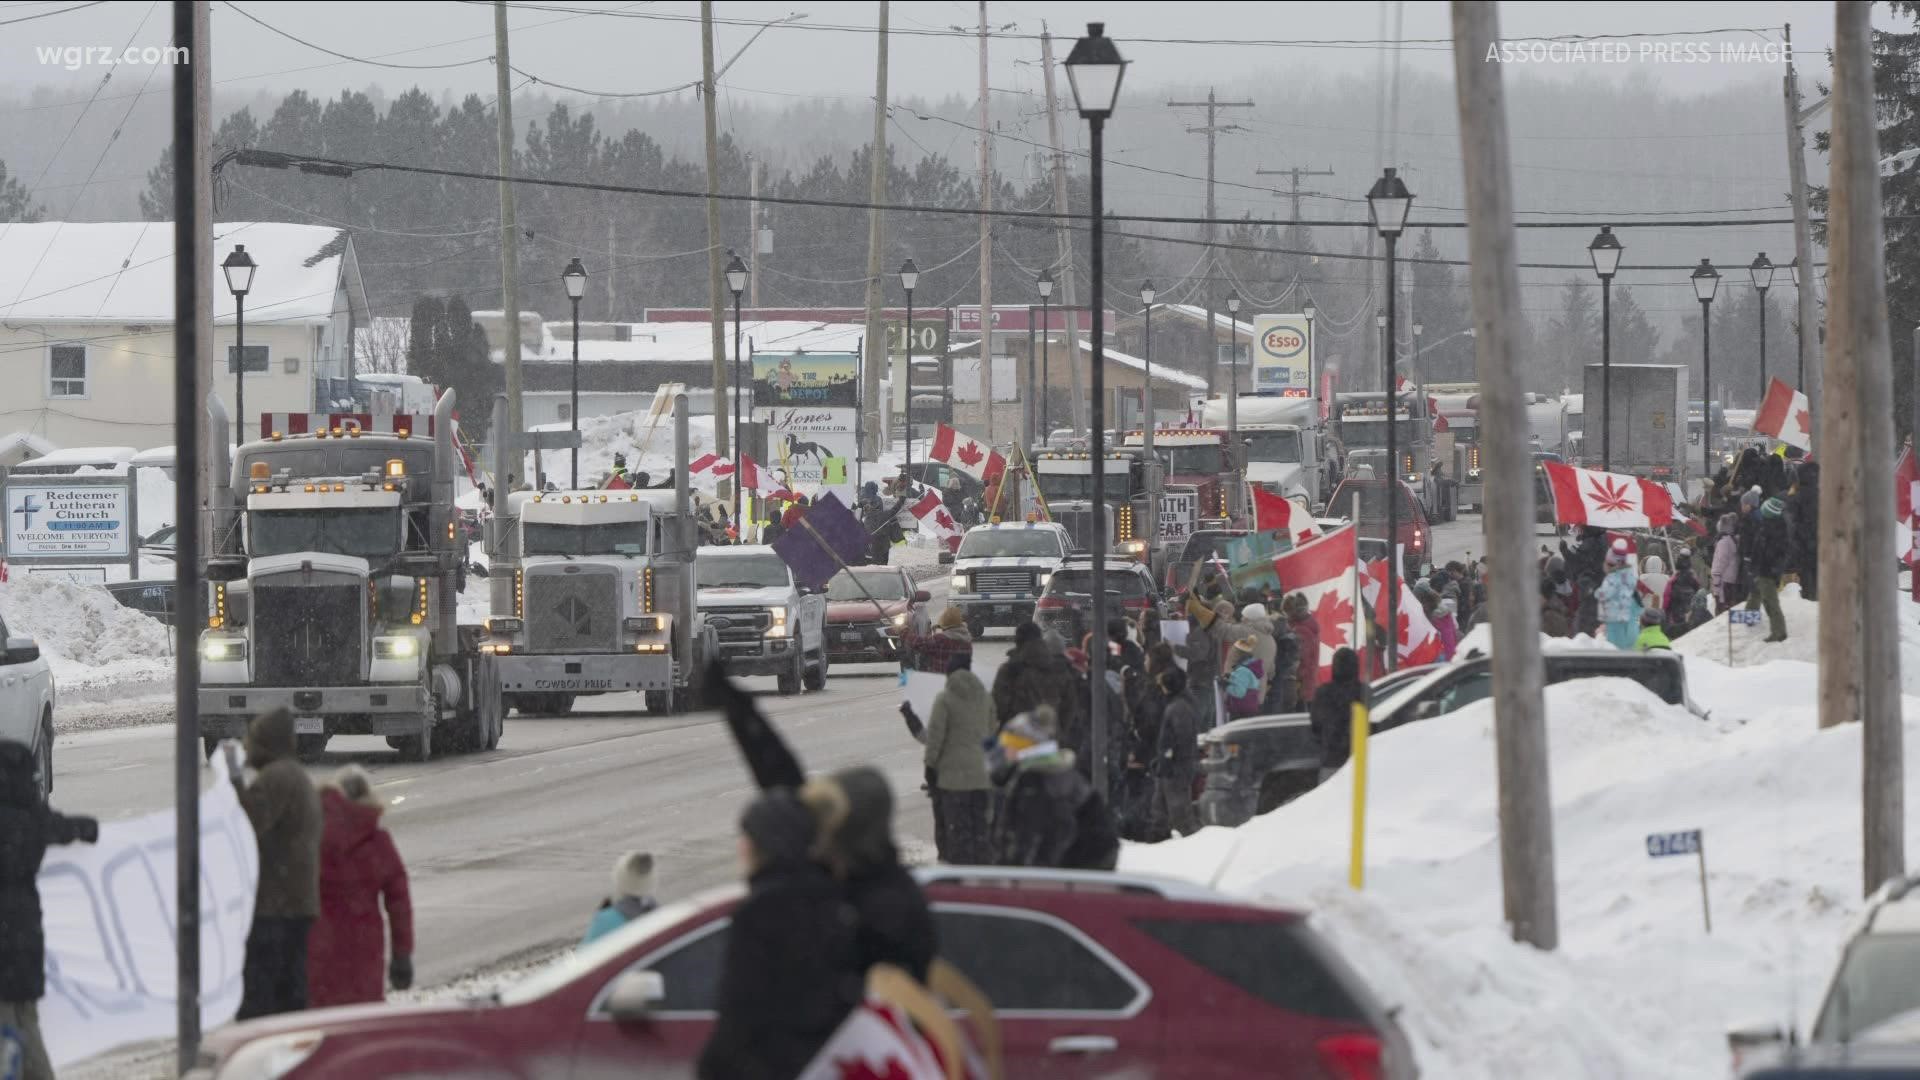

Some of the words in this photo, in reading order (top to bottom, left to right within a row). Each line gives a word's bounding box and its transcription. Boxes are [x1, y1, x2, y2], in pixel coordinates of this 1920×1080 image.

[961, 311, 1001, 322] ESO
[1268, 333, 1300, 348] Esso
[776, 408, 833, 431] Jones
[46, 491, 120, 501] Redeemer
[48, 501, 116, 511] Lutheran
[55, 510, 110, 520] Church
[17, 533, 65, 541] WELCOME
[71, 532, 120, 541] EVERYONE
[534, 679, 581, 689] COWBOY
[583, 679, 613, 689] PRIDE
